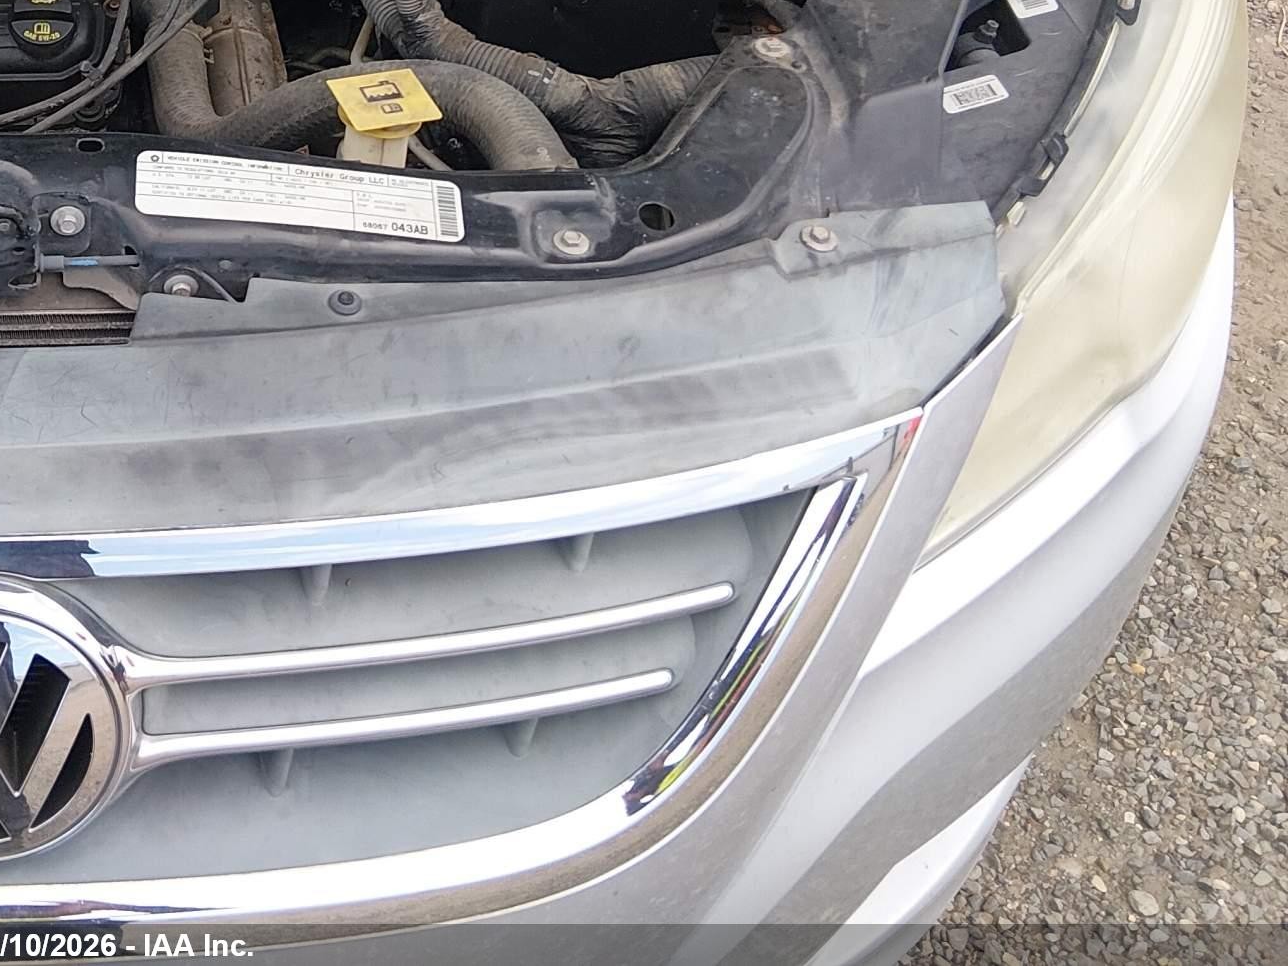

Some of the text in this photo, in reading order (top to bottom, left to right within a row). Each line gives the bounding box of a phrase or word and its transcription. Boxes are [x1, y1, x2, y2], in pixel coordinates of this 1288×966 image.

[295, 168, 334, 179] Chrysler
[339, 173, 365, 183] Group
[368, 176, 385, 185] LLC
[392, 222, 429, 235] 043AB
